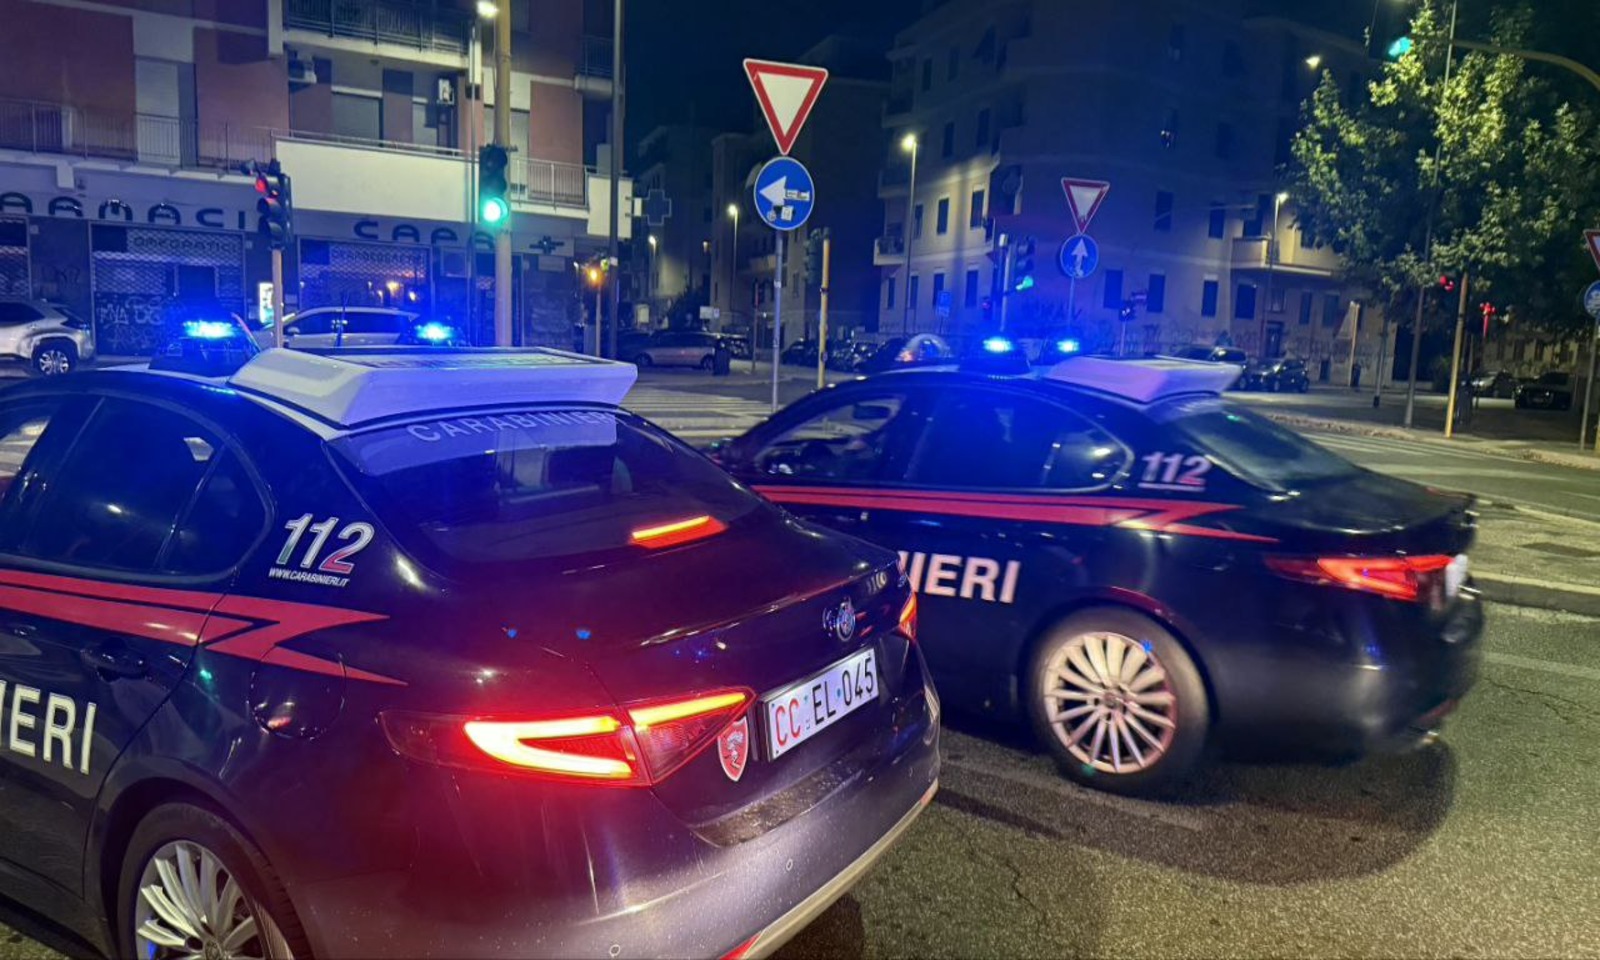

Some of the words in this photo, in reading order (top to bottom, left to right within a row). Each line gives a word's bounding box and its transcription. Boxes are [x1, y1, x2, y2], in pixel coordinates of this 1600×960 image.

[1142, 452, 1212, 486] 112
[275, 512, 375, 574] 112
[775, 698, 801, 747] CC
[812, 681, 836, 726] EL
[841, 657, 875, 706] 045
